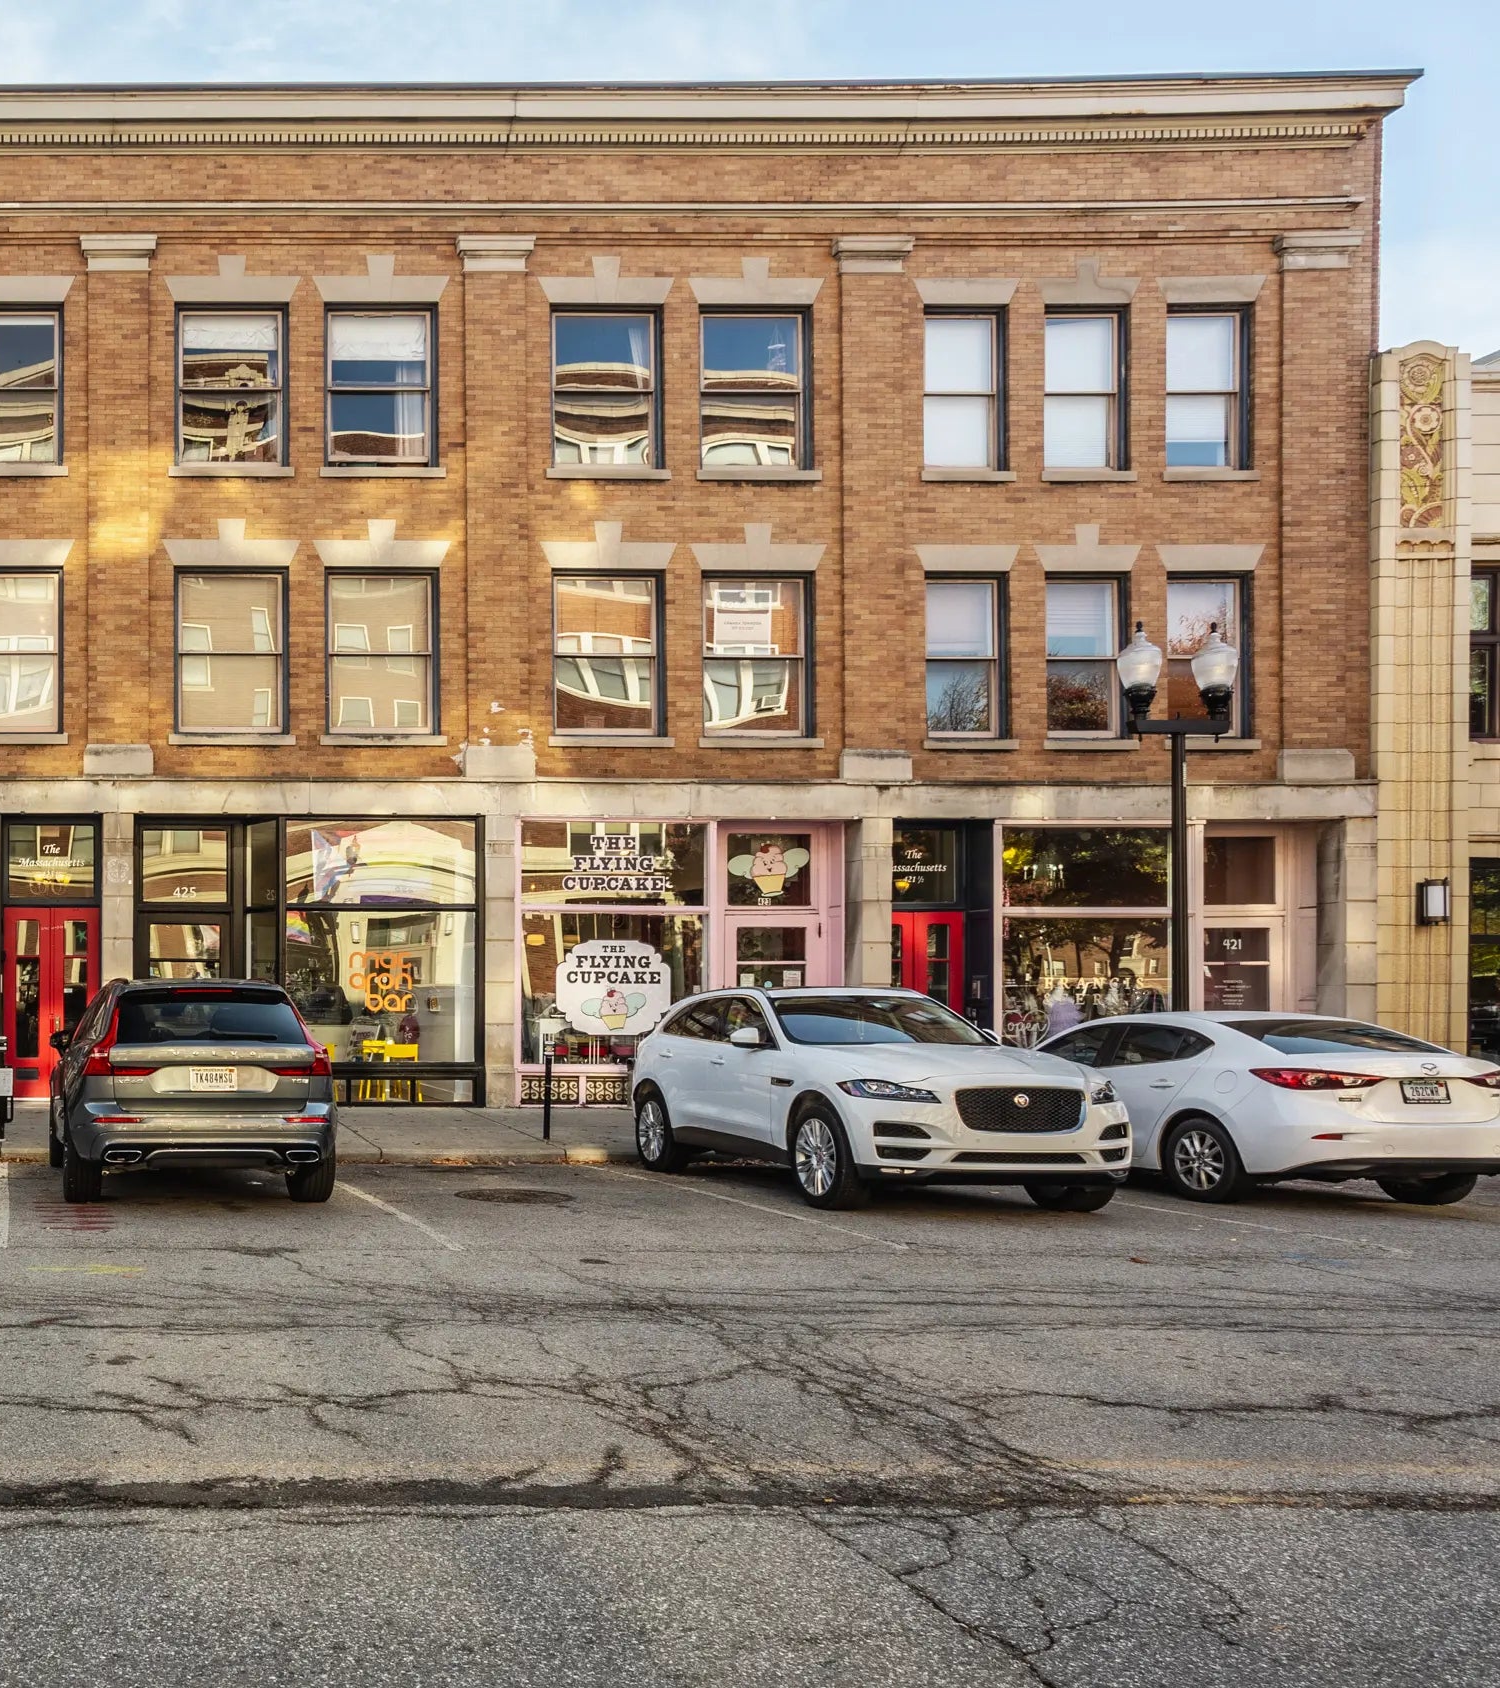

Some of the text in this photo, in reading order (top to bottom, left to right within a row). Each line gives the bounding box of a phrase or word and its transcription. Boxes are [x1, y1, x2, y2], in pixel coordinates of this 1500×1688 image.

[42, 843, 61, 854] The
[591, 836, 636, 850] THE
[904, 848, 923, 860] The
[18, 857, 85, 867] Massachusetts
[573, 856, 654, 871] FLYING
[892, 862, 947, 872] assachusetts
[563, 876, 665, 892] CUPCAKE
[173, 886, 197, 899] 425
[602, 945, 626, 953] THE
[1222, 938, 1242, 950] 421
[348, 951, 413, 969] mac
[576, 955, 652, 969] FLYING
[348, 972, 413, 993] aron
[566, 971, 661, 984] CUPCAKE
[1044, 977, 1145, 990] FRANCIS
[365, 990, 413, 1012] bar
[1043, 993, 1053, 1006] &
[1007, 1019, 1048, 1034] open
[172, 1049, 257, 1057] VOLVO
